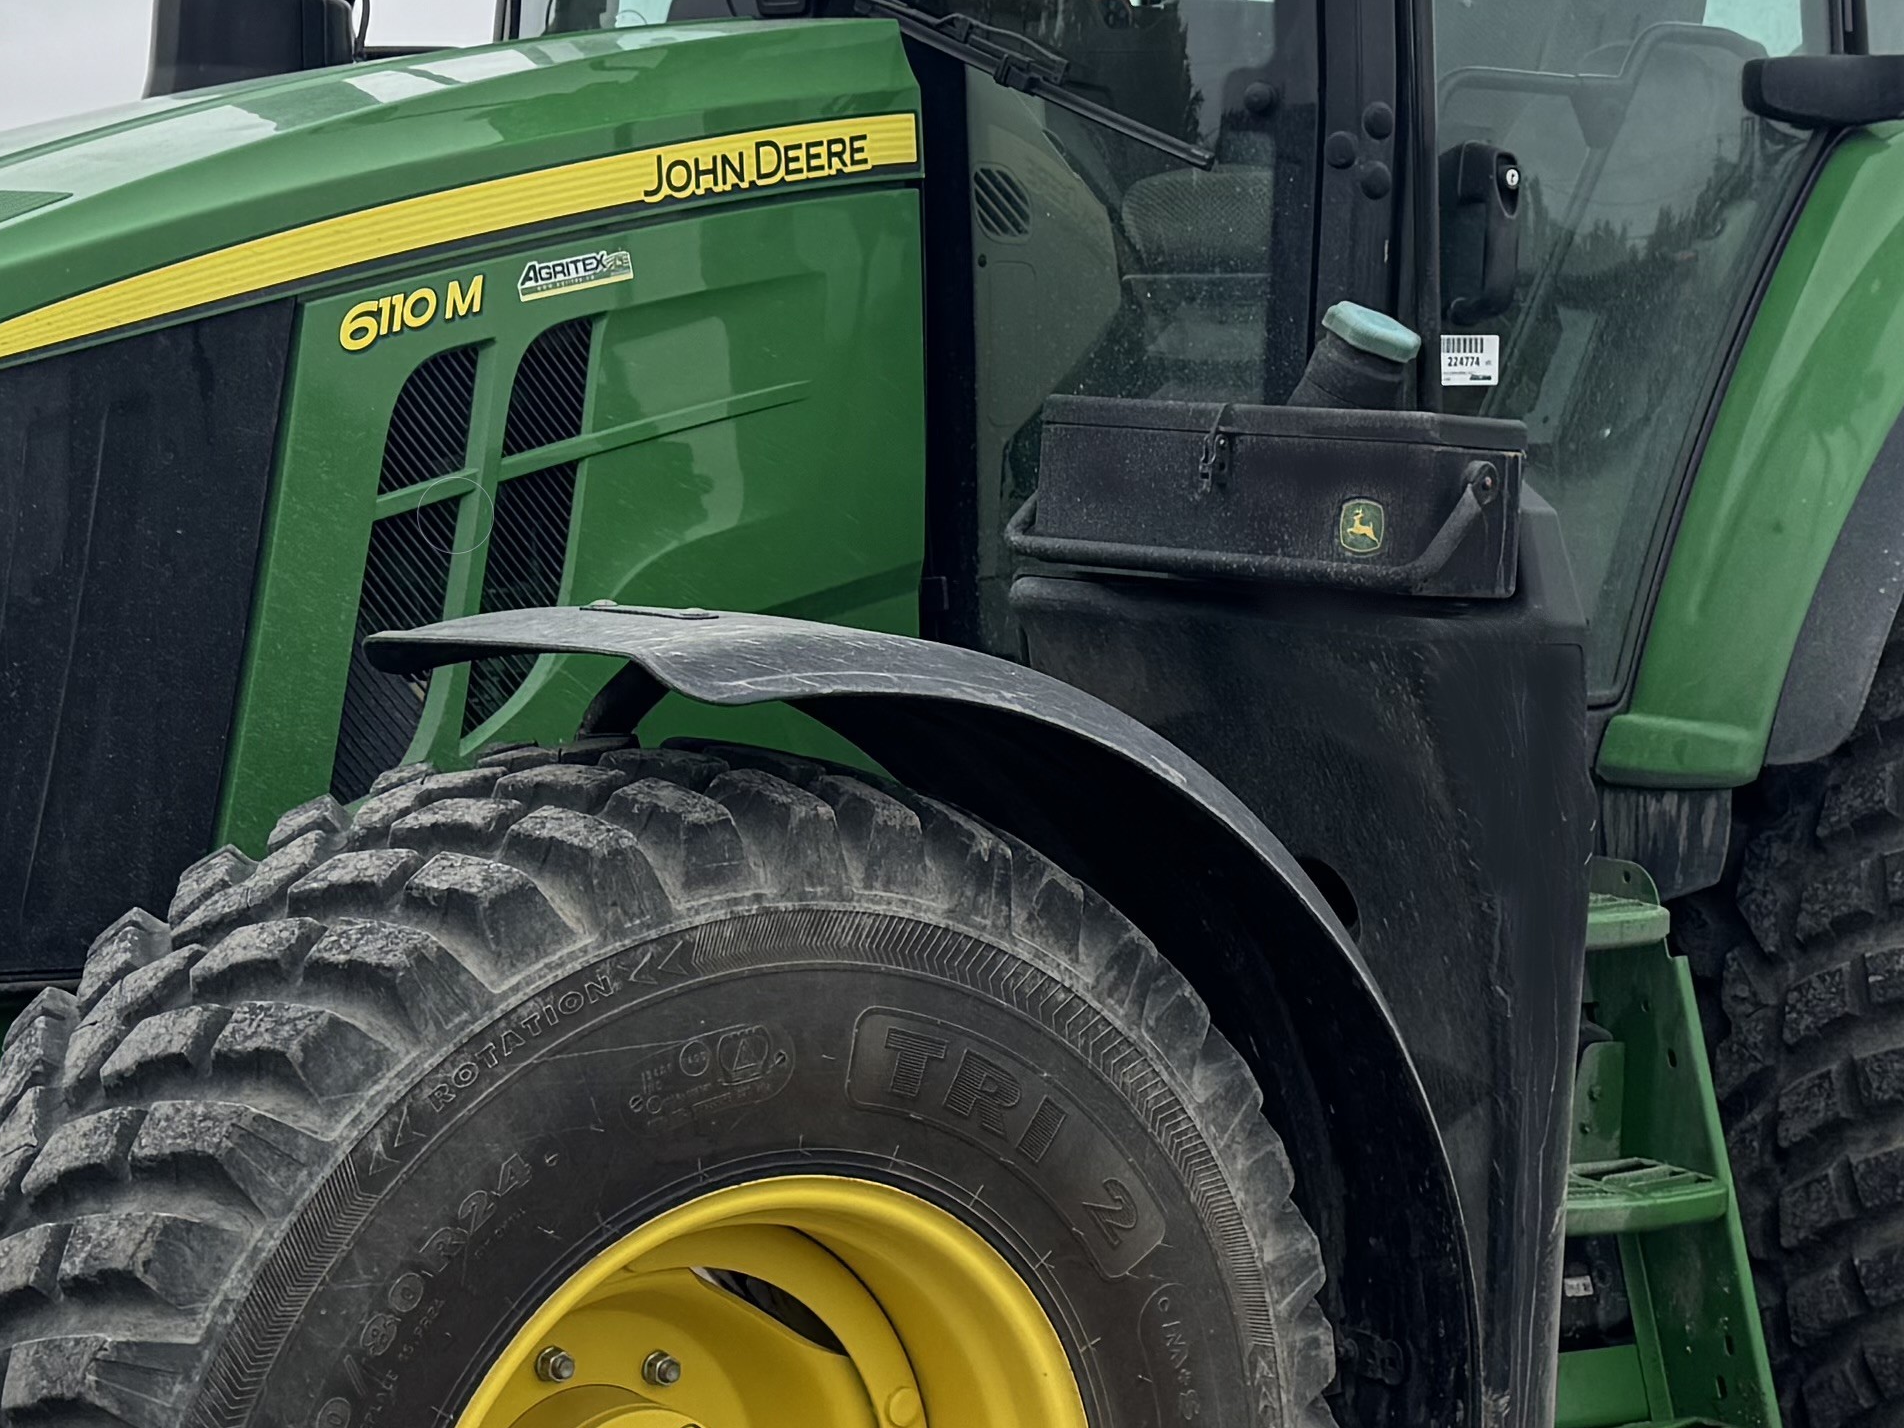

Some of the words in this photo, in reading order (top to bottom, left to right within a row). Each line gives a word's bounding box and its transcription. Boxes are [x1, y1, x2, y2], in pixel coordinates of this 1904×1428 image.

[643, 151, 747, 199] JOHN
[754, 133, 870, 182] DEERE
[520, 253, 608, 287] AGRITEX
[339, 286, 437, 352] 6110
[443, 274, 485, 320] M
[1447, 355, 1481, 368] 224774
[427, 974, 615, 1113] ROTATION
[883, 1026, 1070, 1164] TRI
[1081, 1176, 1140, 1249] 2
